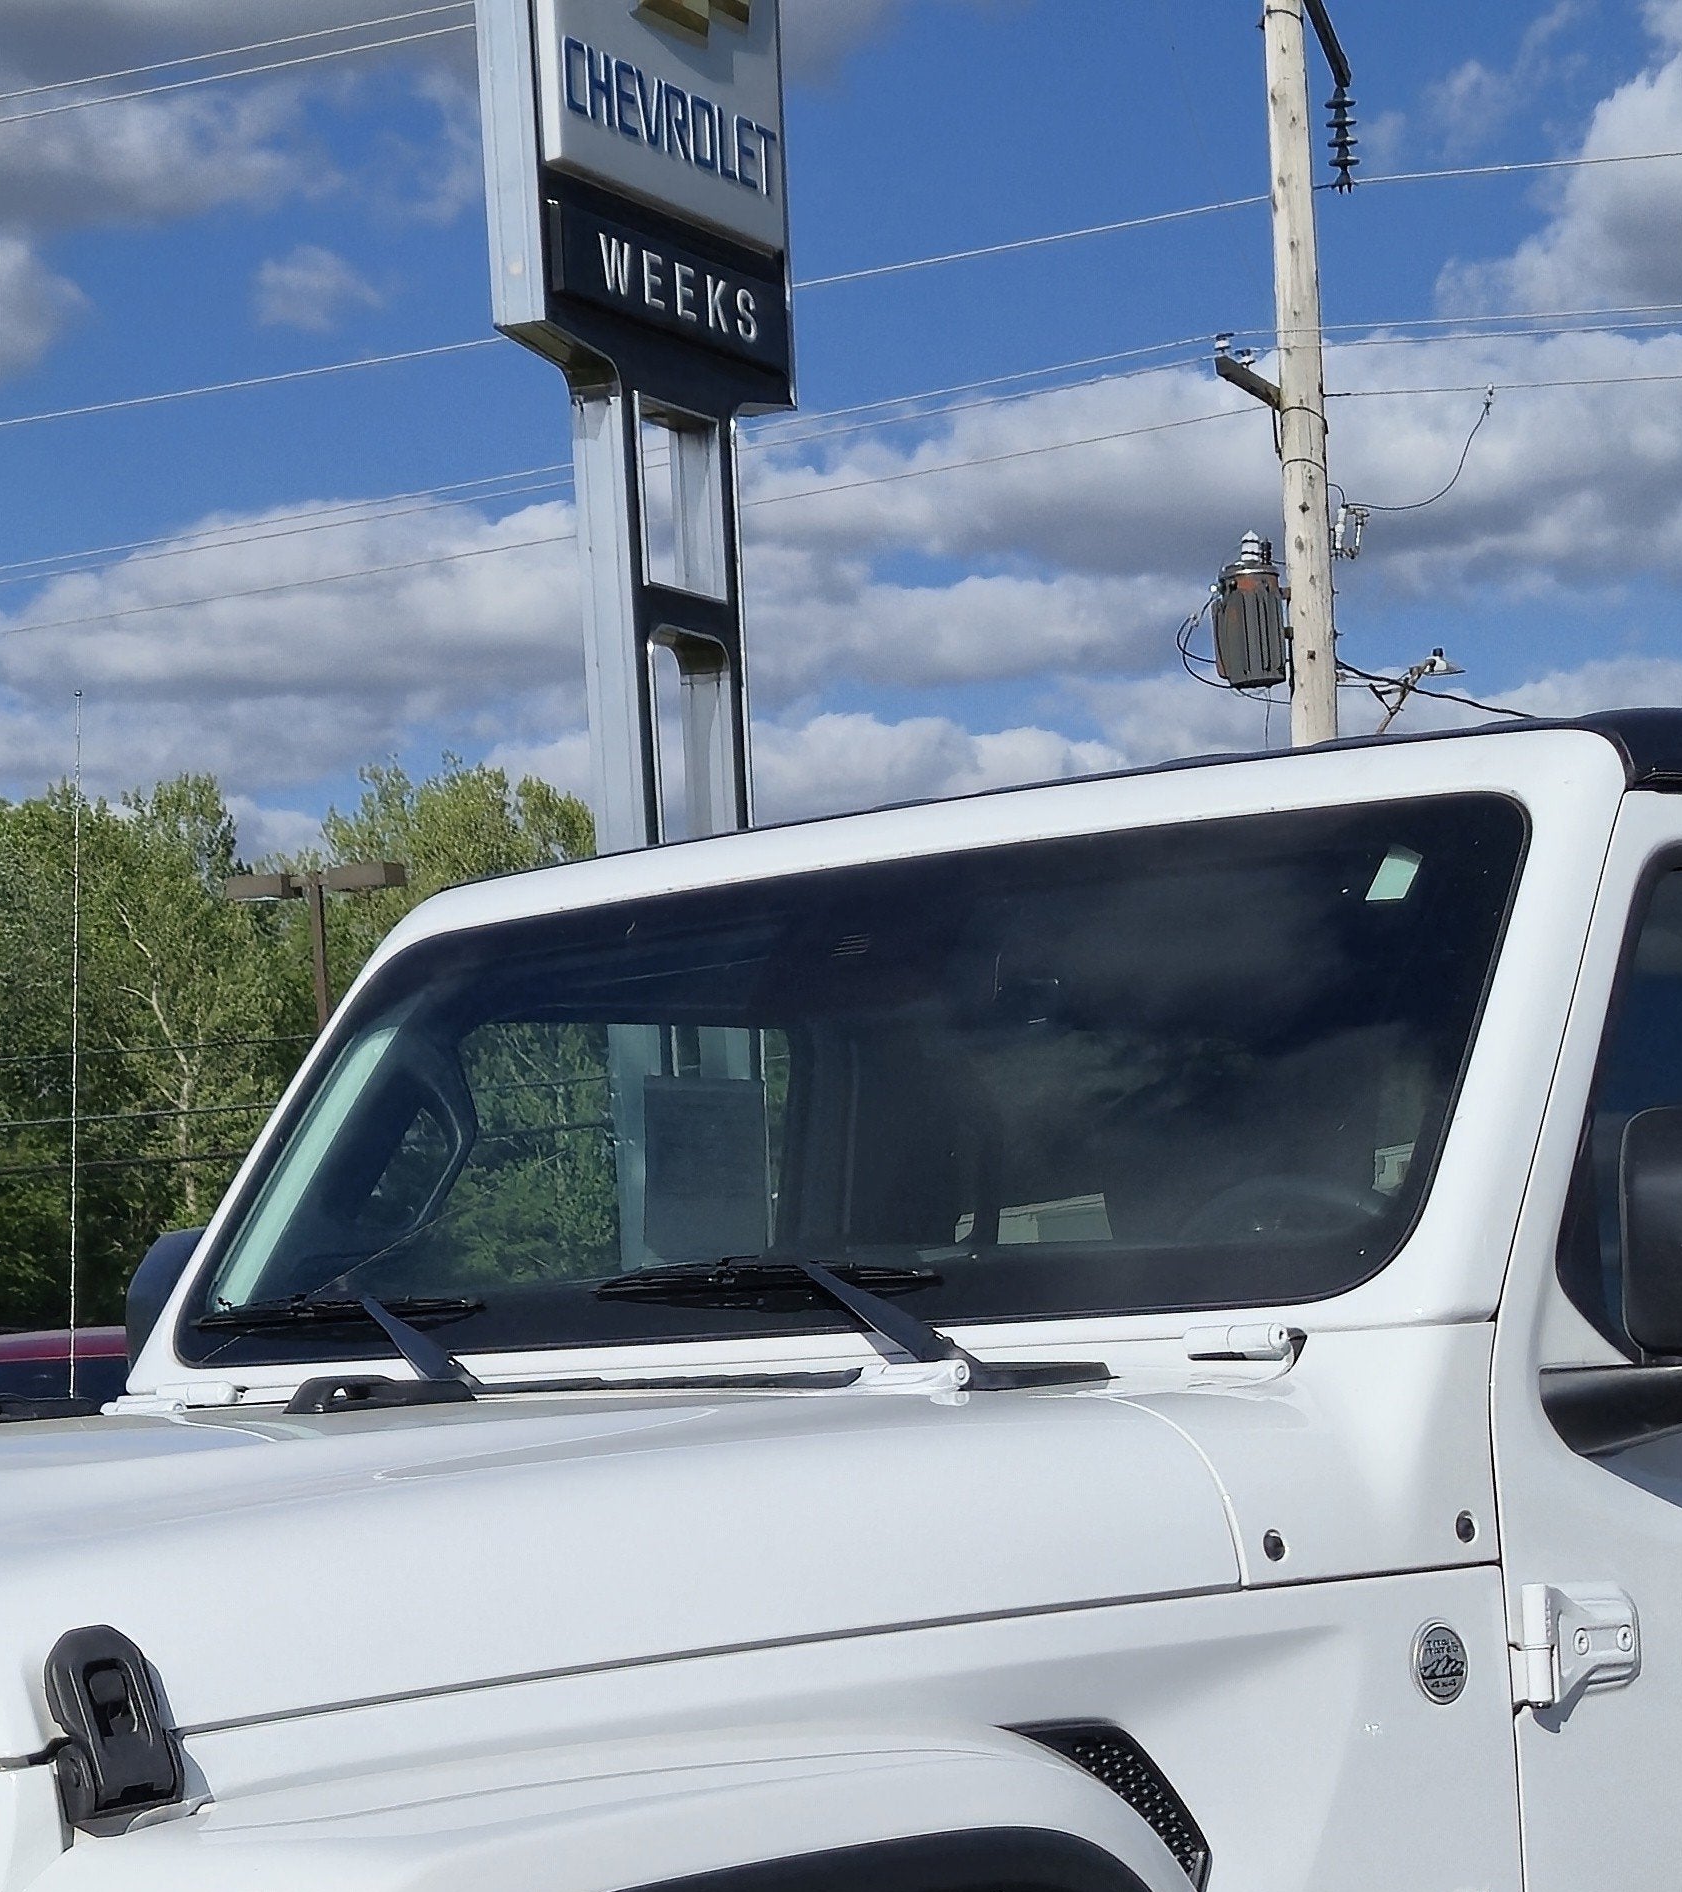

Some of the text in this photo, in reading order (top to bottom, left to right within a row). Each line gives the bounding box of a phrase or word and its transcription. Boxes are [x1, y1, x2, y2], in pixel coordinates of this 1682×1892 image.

[562, 36, 777, 196] CHEVROLET
[598, 231, 758, 344] WEEKS
[1430, 1679, 1457, 1688] 4x4
